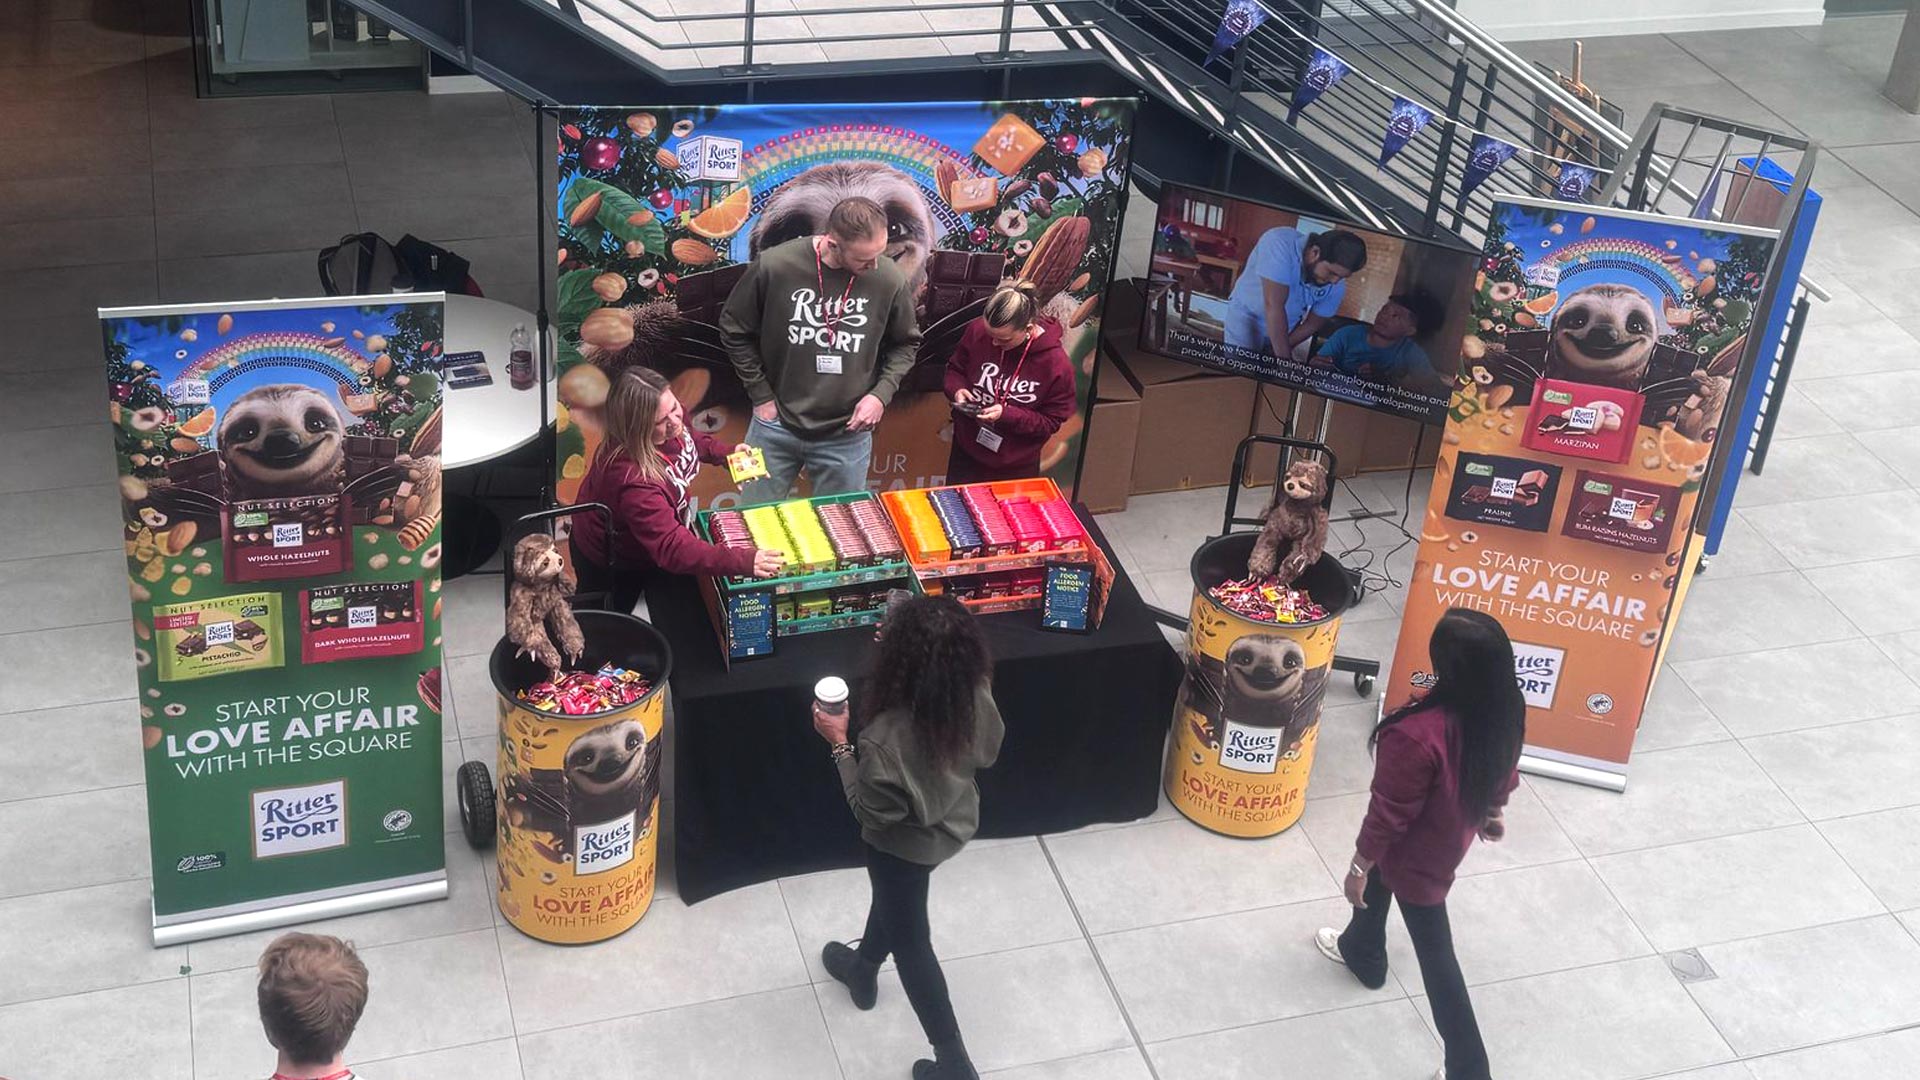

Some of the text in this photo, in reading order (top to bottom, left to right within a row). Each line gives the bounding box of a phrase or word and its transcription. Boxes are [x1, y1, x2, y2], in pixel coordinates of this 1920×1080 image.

[707, 160, 736, 169] SPORT
[789, 288, 869, 327] Ritter
[787, 325, 866, 353] SPORT
[1169, 329, 1195, 344] That's
[1197, 338, 1217, 354] why
[1219, 344, 1233, 352] we
[1235, 345, 1260, 360] focus
[1261, 354, 1274, 364] on
[1276, 357, 1312, 375] training
[1313, 367, 1330, 377] our
[1331, 374, 1385, 392] employees
[1429, 396, 1449, 407] and
[1181, 347, 1226, 365] providing
[1226, 358, 1288, 380] opportunities
[1290, 372, 1304, 383] for
[1305, 378, 1363, 398] professional
[1554, 438, 1600, 449] MARZIPAN
[873, 454, 907, 473] UR
[238, 498, 335, 512] NUT SELECTION
[1484, 508, 1512, 517] PRALINE
[1575, 523, 1591, 531] RUM
[1618, 530, 1658, 544] HAZELNUTS
[247, 549, 330, 562] WHOLE HAZELNUTS
[1479, 550, 1610, 588] START YOUR
[315, 584, 409, 597] NUT SELECTION
[1432, 563, 1647, 621] LOVE AFFAIR
[170, 596, 265, 614] NUT SELECTION
[1435, 588, 1635, 640] WITH THE SQUARE
[208, 633, 232, 641] SPORT
[315, 640, 336, 648] DARK
[337, 636, 365, 645] WHOLE
[366, 633, 411, 642] HAZELNUTS
[202, 651, 241, 662] PISTACHIO
[1514, 655, 1555, 676] tter
[1516, 677, 1551, 694] ORT
[216, 686, 371, 723] START YOUR
[167, 704, 420, 758] LOVE AFFAIR
[1229, 729, 1276, 751] Ritter
[175, 731, 412, 779] WITH THE SQUARE
[1225, 748, 1274, 763] SPORT
[1182, 770, 1298, 810] LOVE AFFAIR
[1203, 771, 1282, 795] START YOUR
[260, 792, 338, 825] Ritter
[1183, 786, 1292, 822] WITH THE SQUARE
[262, 818, 339, 842] SPORT
[581, 823, 631, 851] Ritter
[580, 840, 631, 864] SPORT
[560, 865, 642, 898] START YOUR
[533, 895, 591, 914] LOVE
[536, 912, 576, 928] WITH
[581, 912, 608, 927] THE
